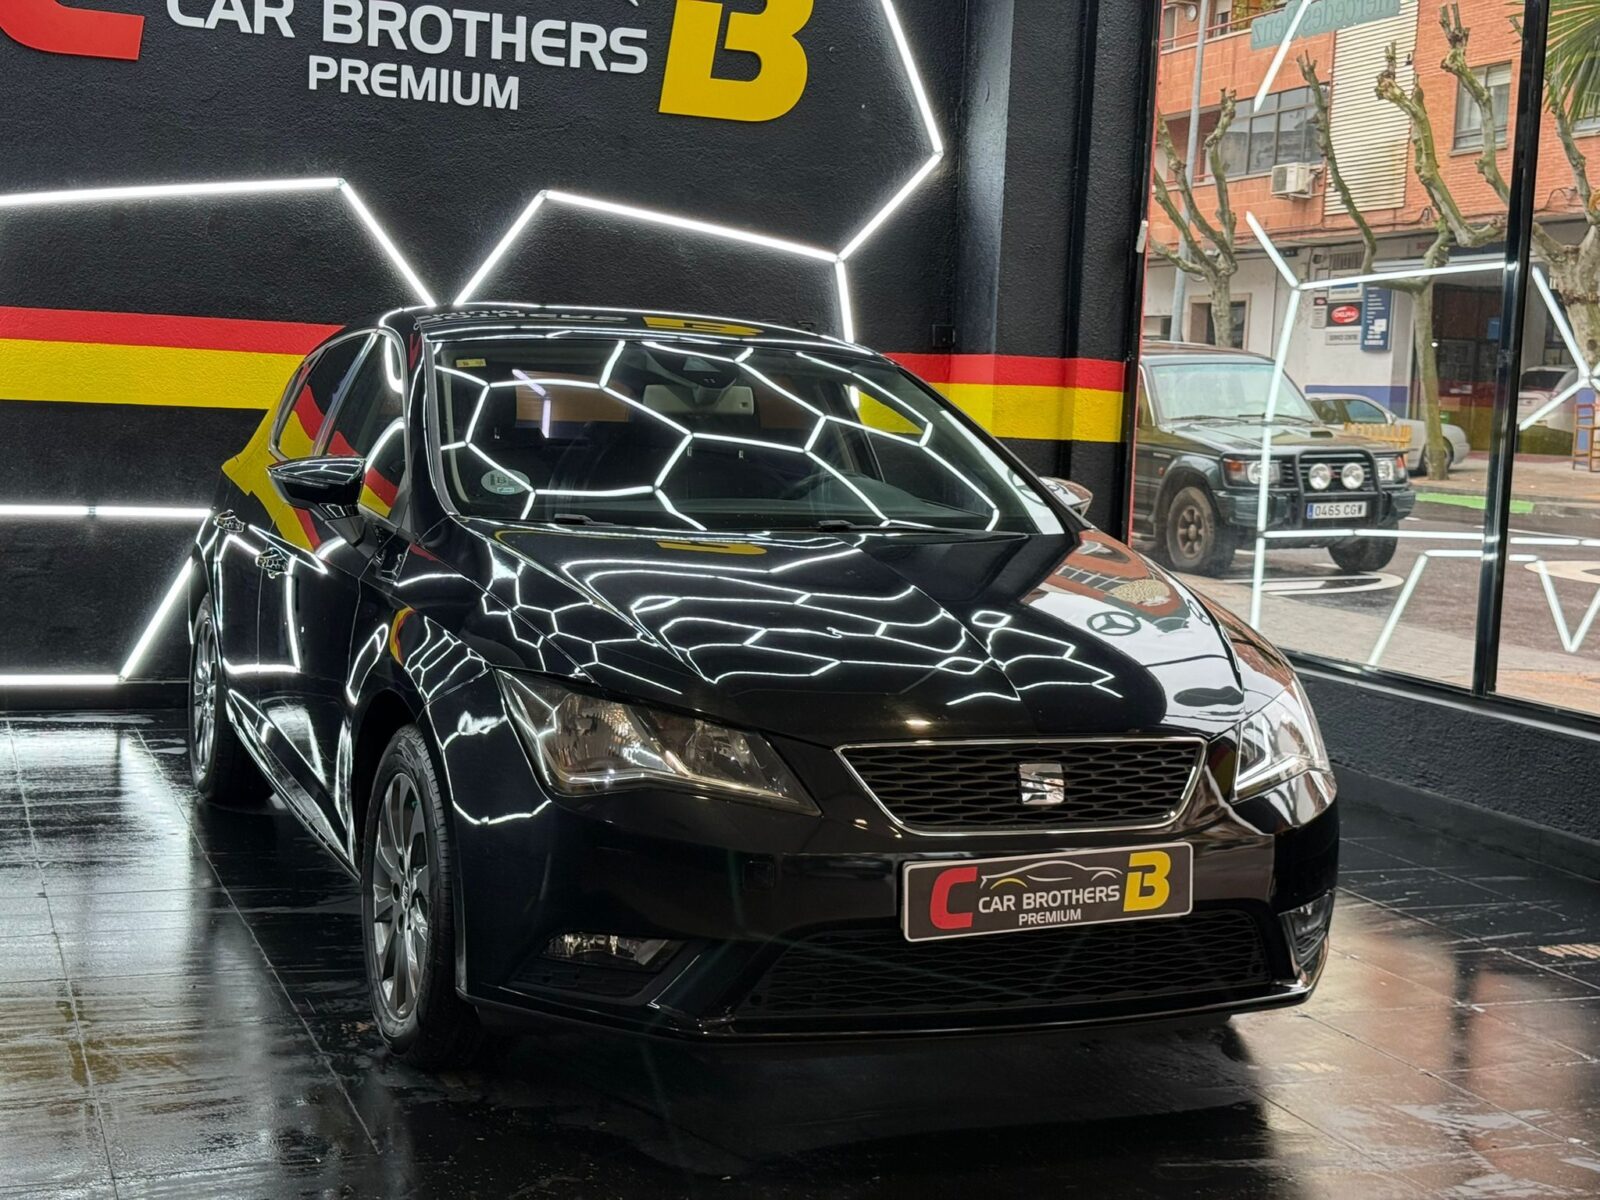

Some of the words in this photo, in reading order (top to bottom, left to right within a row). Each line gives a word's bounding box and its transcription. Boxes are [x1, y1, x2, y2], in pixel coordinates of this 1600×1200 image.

[167, 0, 296, 38] CAR
[322, 0, 648, 75] BROTHERS
[308, 55, 520, 110] PREMIUM
[1314, 504, 1341, 516] 0465
[930, 866, 978, 930] C
[978, 896, 1016, 914] CAR
[1022, 885, 1120, 910] BROTHERS
[1018, 908, 1082, 926] PREMIUM
